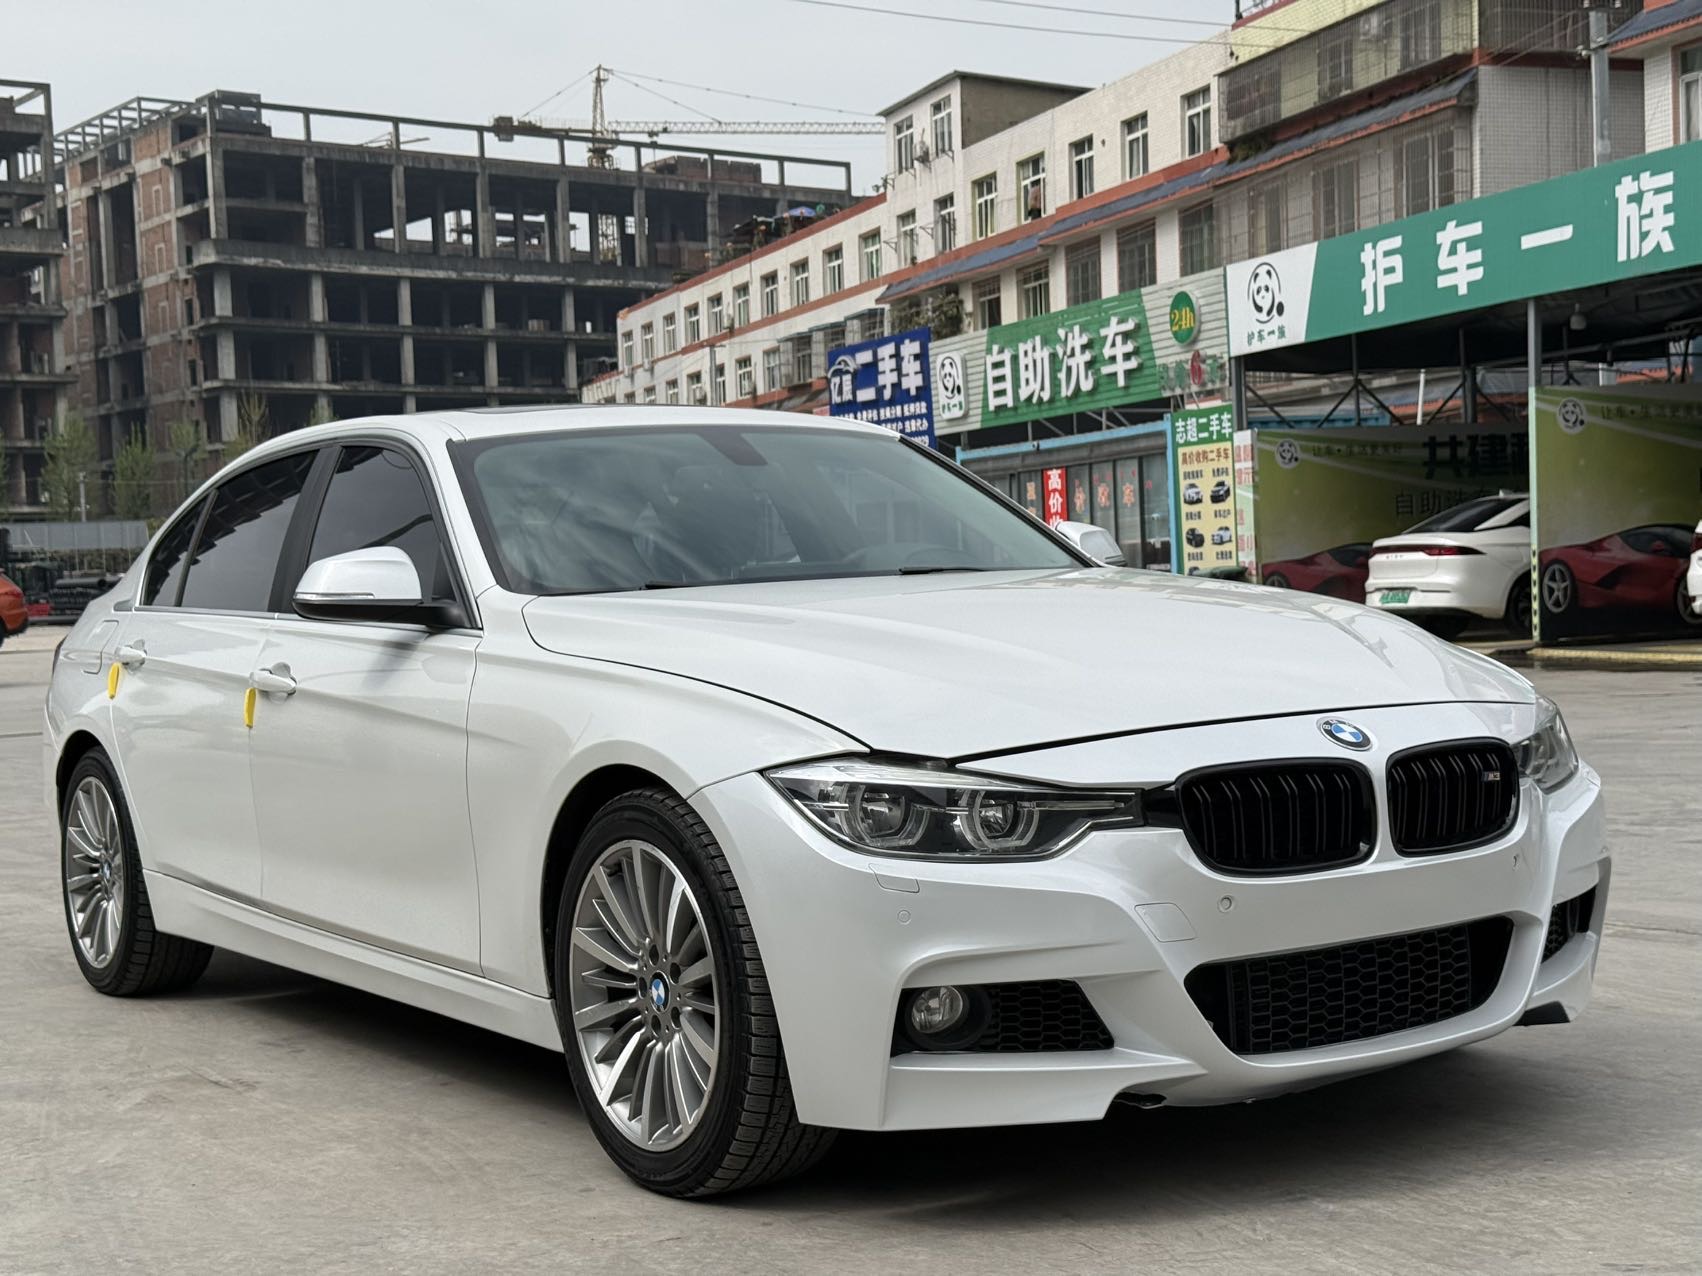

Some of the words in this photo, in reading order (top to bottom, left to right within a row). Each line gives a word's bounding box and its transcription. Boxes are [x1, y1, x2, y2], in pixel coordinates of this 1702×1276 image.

[1361, 171, 1675, 315] 护车一族
[1171, 306, 1195, 332] 24h
[985, 316, 1138, 411] 自助洗车
[1175, 412, 1232, 443] 志超二手车
